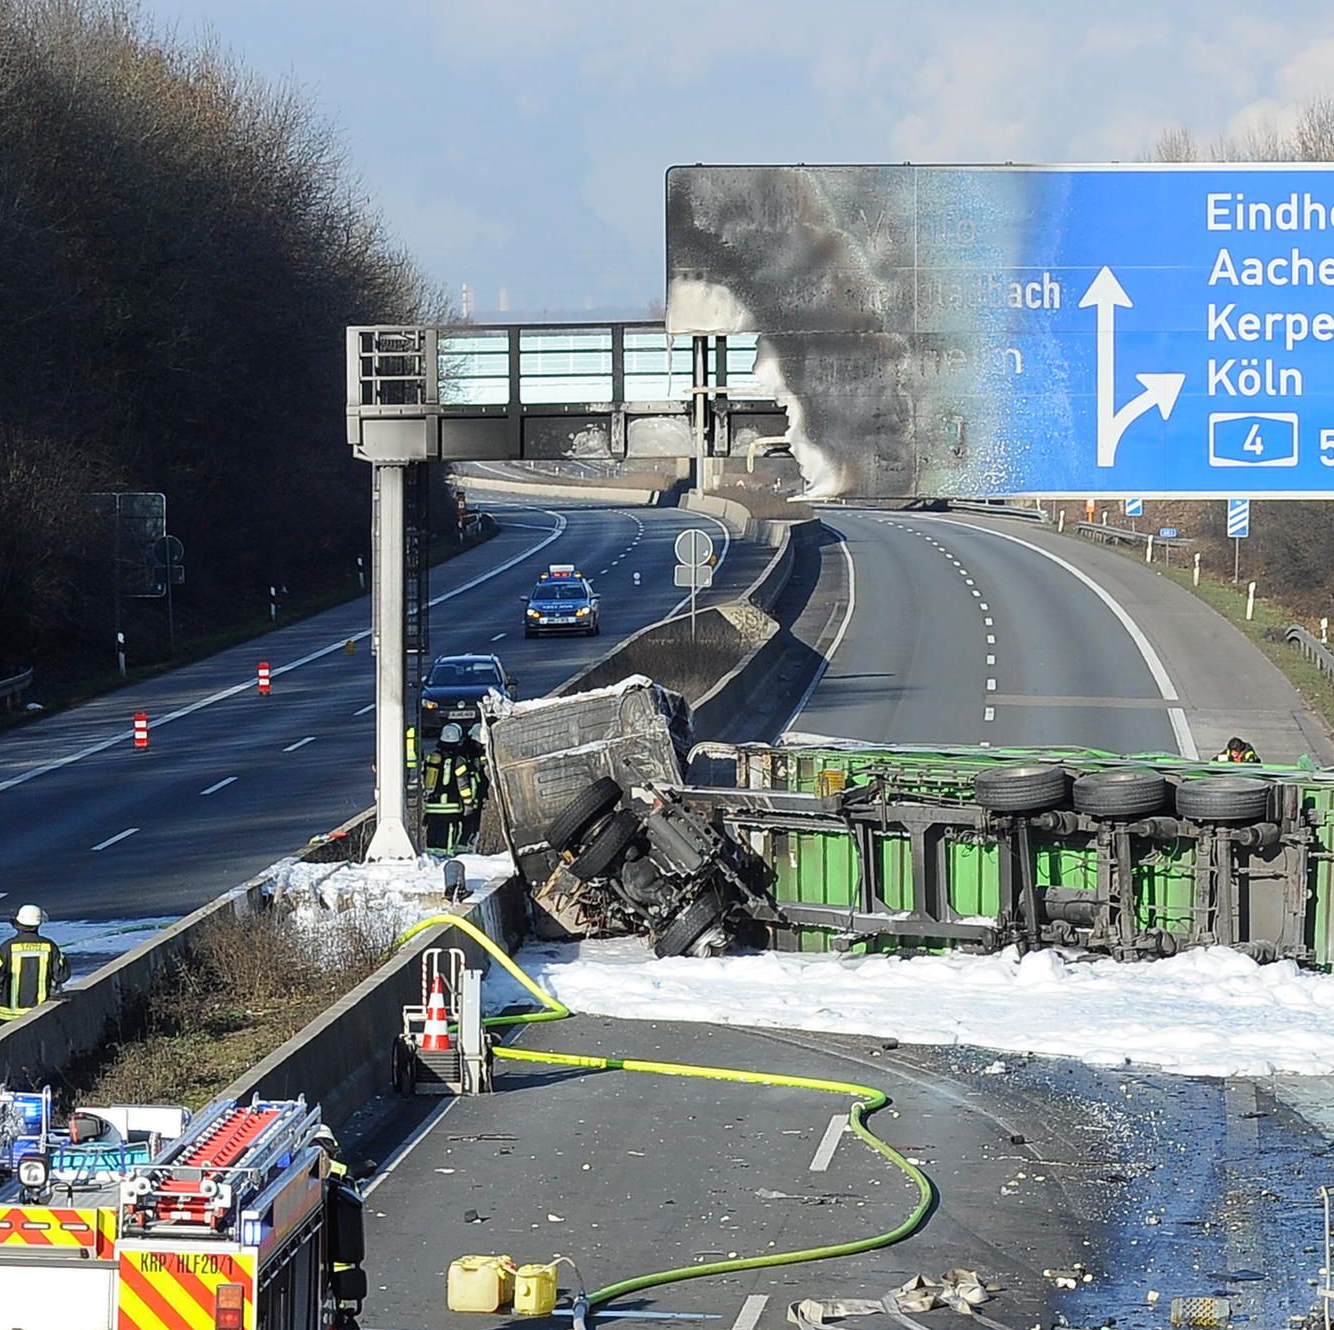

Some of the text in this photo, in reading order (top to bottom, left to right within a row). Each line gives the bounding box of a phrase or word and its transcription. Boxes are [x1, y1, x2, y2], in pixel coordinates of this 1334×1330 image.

[1208, 359, 1302, 395] Köln
[1243, 424, 1264, 455] 4
[140, 1254, 234, 1275] KRP/HLF20/1
